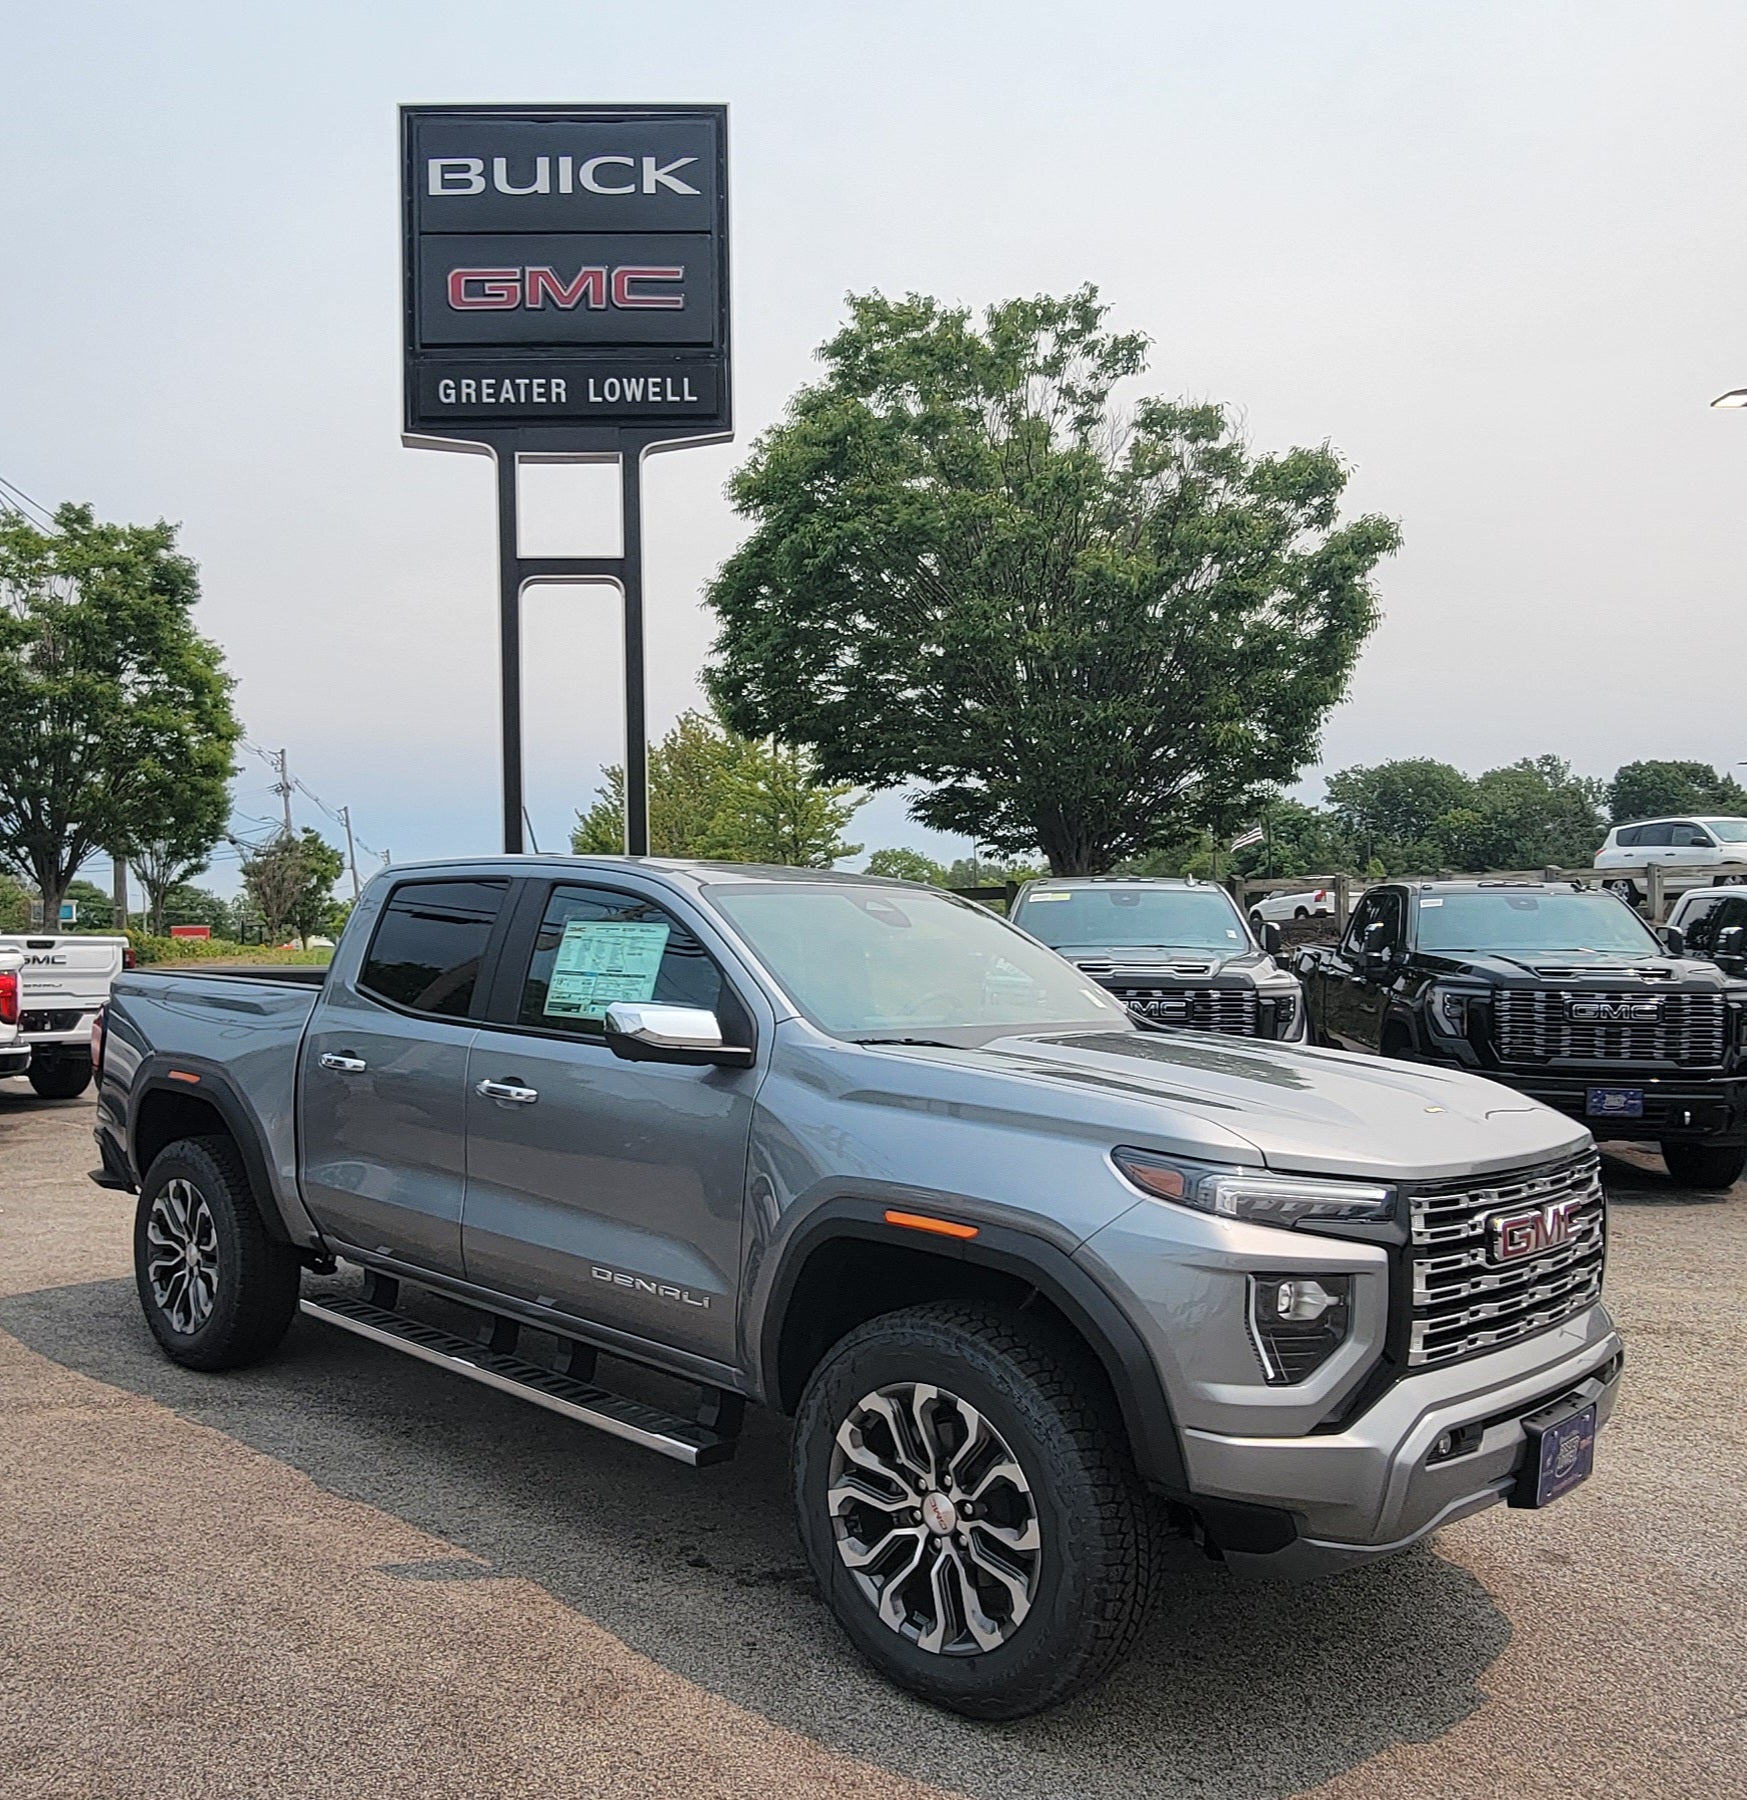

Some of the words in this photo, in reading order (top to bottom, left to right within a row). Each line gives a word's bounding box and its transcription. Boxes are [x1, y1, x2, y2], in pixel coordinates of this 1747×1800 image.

[427, 156, 701, 196] BUICK
[447, 265, 686, 310] GMC
[438, 378, 567, 404] GREATER
[588, 376, 698, 402] LOWELL
[1120, 1000, 1187, 1017] MC
[1571, 1003, 1659, 1020] GMC
[1493, 1198, 1583, 1261] GMC
[590, 1265, 711, 1309] DENALI
